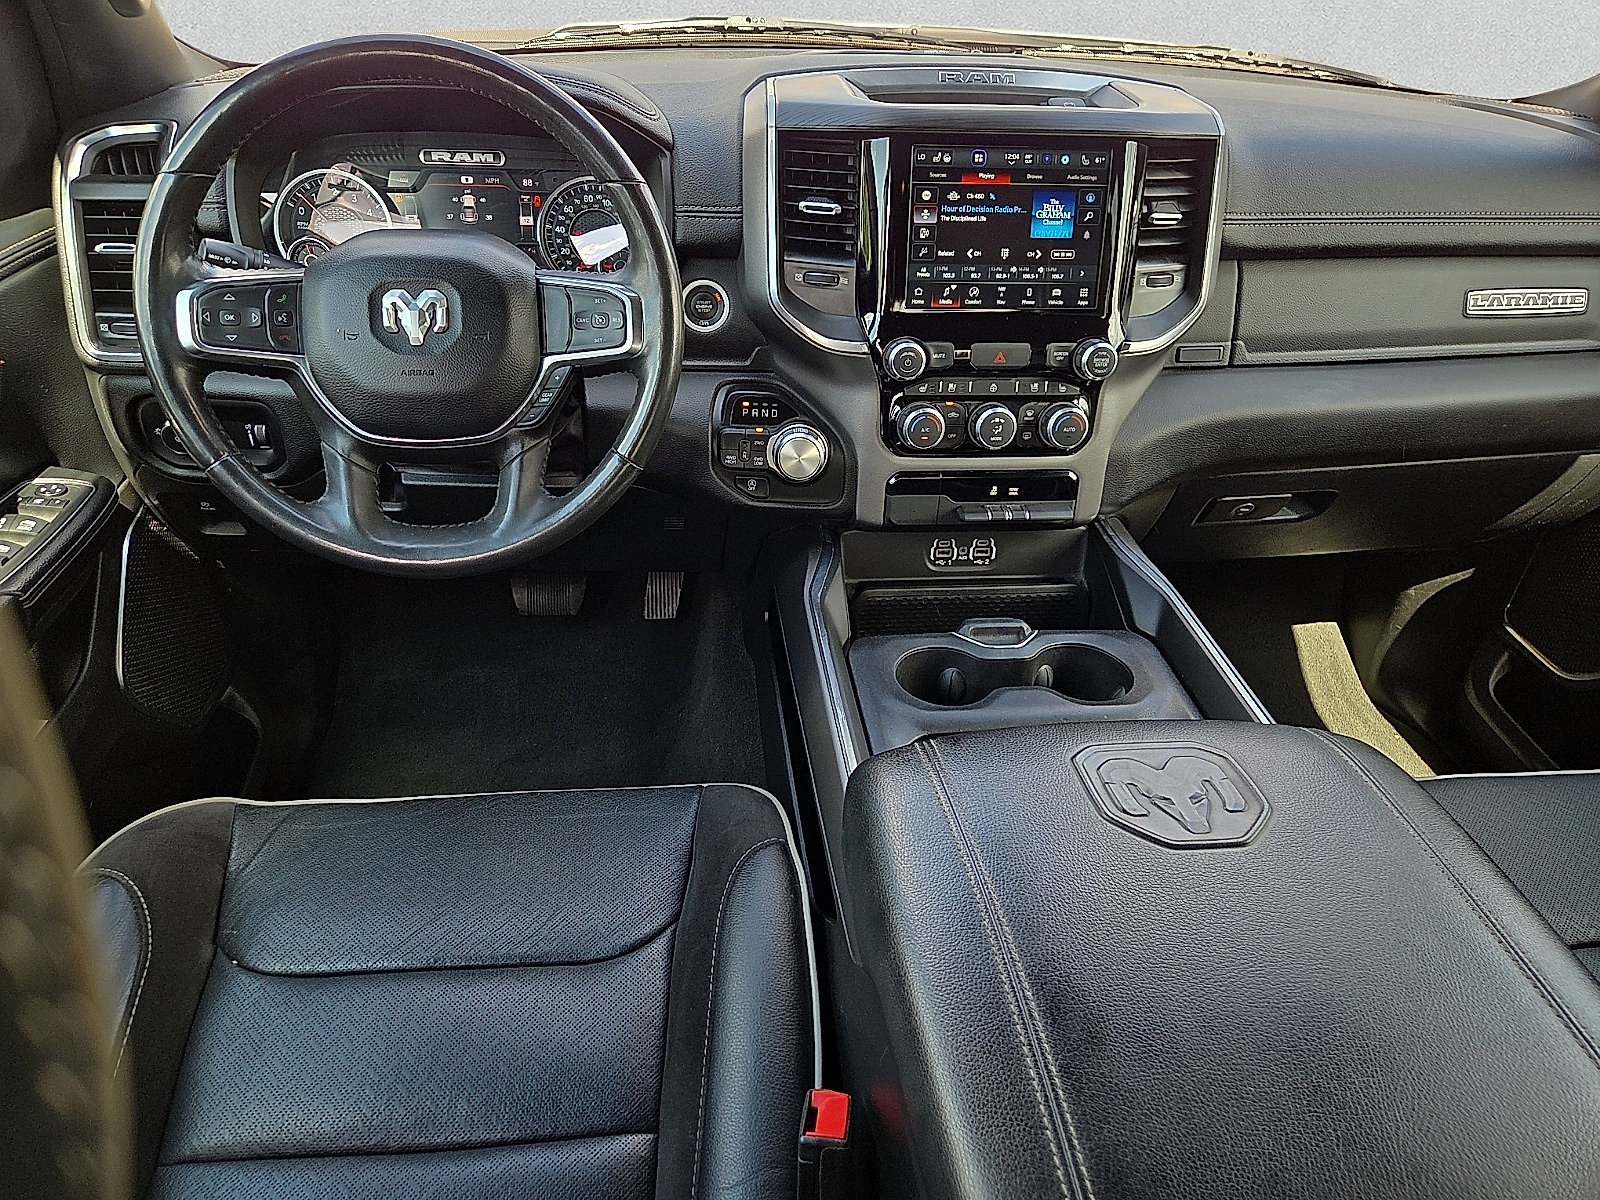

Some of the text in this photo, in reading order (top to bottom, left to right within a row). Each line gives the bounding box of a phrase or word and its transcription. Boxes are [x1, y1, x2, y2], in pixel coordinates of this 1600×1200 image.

[938, 70, 1016, 85] RAM
[430, 151, 495, 164] RAM
[978, 172, 996, 180] Playing
[485, 177, 500, 185] MPH
[522, 178, 533, 187] 88
[351, 193, 358, 203] 3
[574, 198, 581, 206] 70
[583, 195, 594, 203] 80
[298, 207, 305, 216] 0
[366, 208, 374, 217] 4
[563, 205, 574, 214] 60
[941, 205, 958, 213] Hour
[960, 204, 966, 213] of
[966, 204, 994, 214] Decision
[994, 205, 1013, 214] Radio
[1035, 210, 1072, 220] GRAHAM
[555, 225, 566, 234] 40
[560, 247, 571, 256] 20
[1076, 299, 1089, 307] Apps
[1470, 294, 1585, 308] LARAMIE
[224, 313, 236, 321] OK
